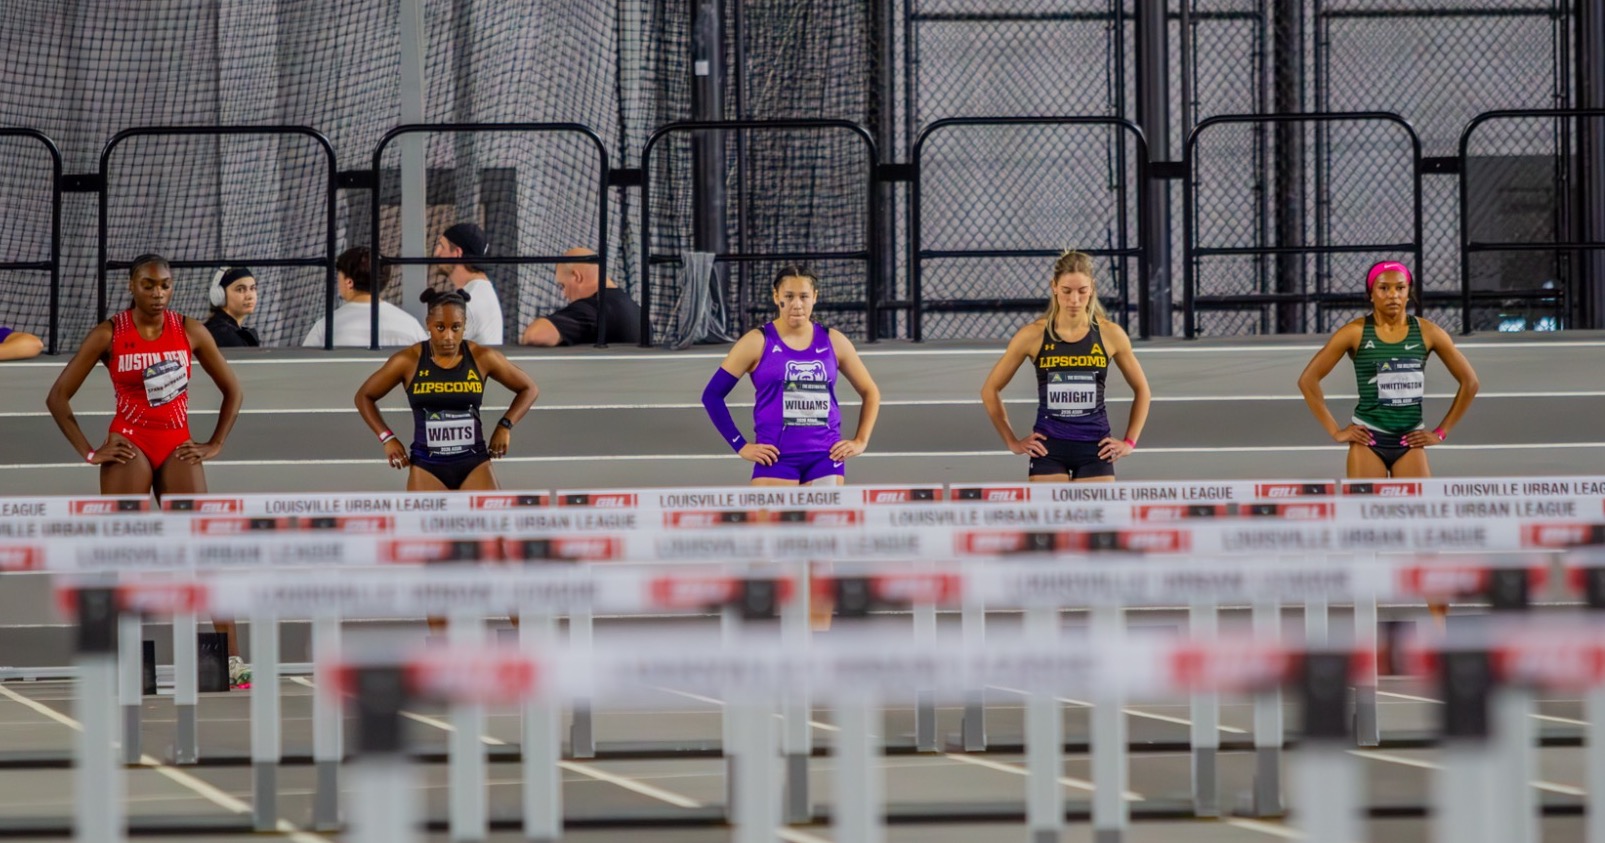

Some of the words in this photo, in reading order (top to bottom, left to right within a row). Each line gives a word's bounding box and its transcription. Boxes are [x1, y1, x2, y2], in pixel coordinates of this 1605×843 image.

[118, 352, 162, 373] AUSTIN
[1039, 355, 1107, 368] LIPSCOMB
[413, 382, 482, 394] LIPSCOMB
[1380, 382, 1422, 390] WHITTINGTON
[1049, 391, 1095, 404] WRIGHT
[784, 400, 829, 411] WILLIAMS
[428, 425, 473, 442] WATTS
[988, 490, 1018, 502] GILL
[1052, 488, 1127, 501] LOUISVILLE
[1131, 488, 1177, 501] URBAN
[1182, 487, 1233, 500] LEAGUE
[1268, 486, 1299, 498] GILL
[1380, 485, 1410, 497] GILL
[1443, 483, 1519, 497] LOUISVILLE
[1523, 482, 1569, 496] URBAN
[1574, 482, 1605, 496] LEAG
[265, 500, 340, 514] LOUISVILLE
[345, 499, 391, 513] URBAN
[396, 498, 448, 512] LEAGUE
[660, 494, 735, 508] LOUISVILLE
[740, 493, 785, 506] URBAN
[790, 492, 841, 506] LEAGUE
[0, 502, 47, 517] EAGUE
[1361, 503, 1450, 520] LOUISVILLE
[1456, 502, 1510, 519] URBAN
[1515, 501, 1578, 518] LEAGUE
[420, 516, 511, 534] LOUISVILLE
[515, 514, 571, 532] URBAN
[575, 513, 638, 531] LEAGUE
[889, 510, 978, 528] LOUISVILLE
[983, 509, 1039, 526] URBAN
[1044, 507, 1105, 525] LEAGUE
[102, 520, 164, 537] LEAGUE
